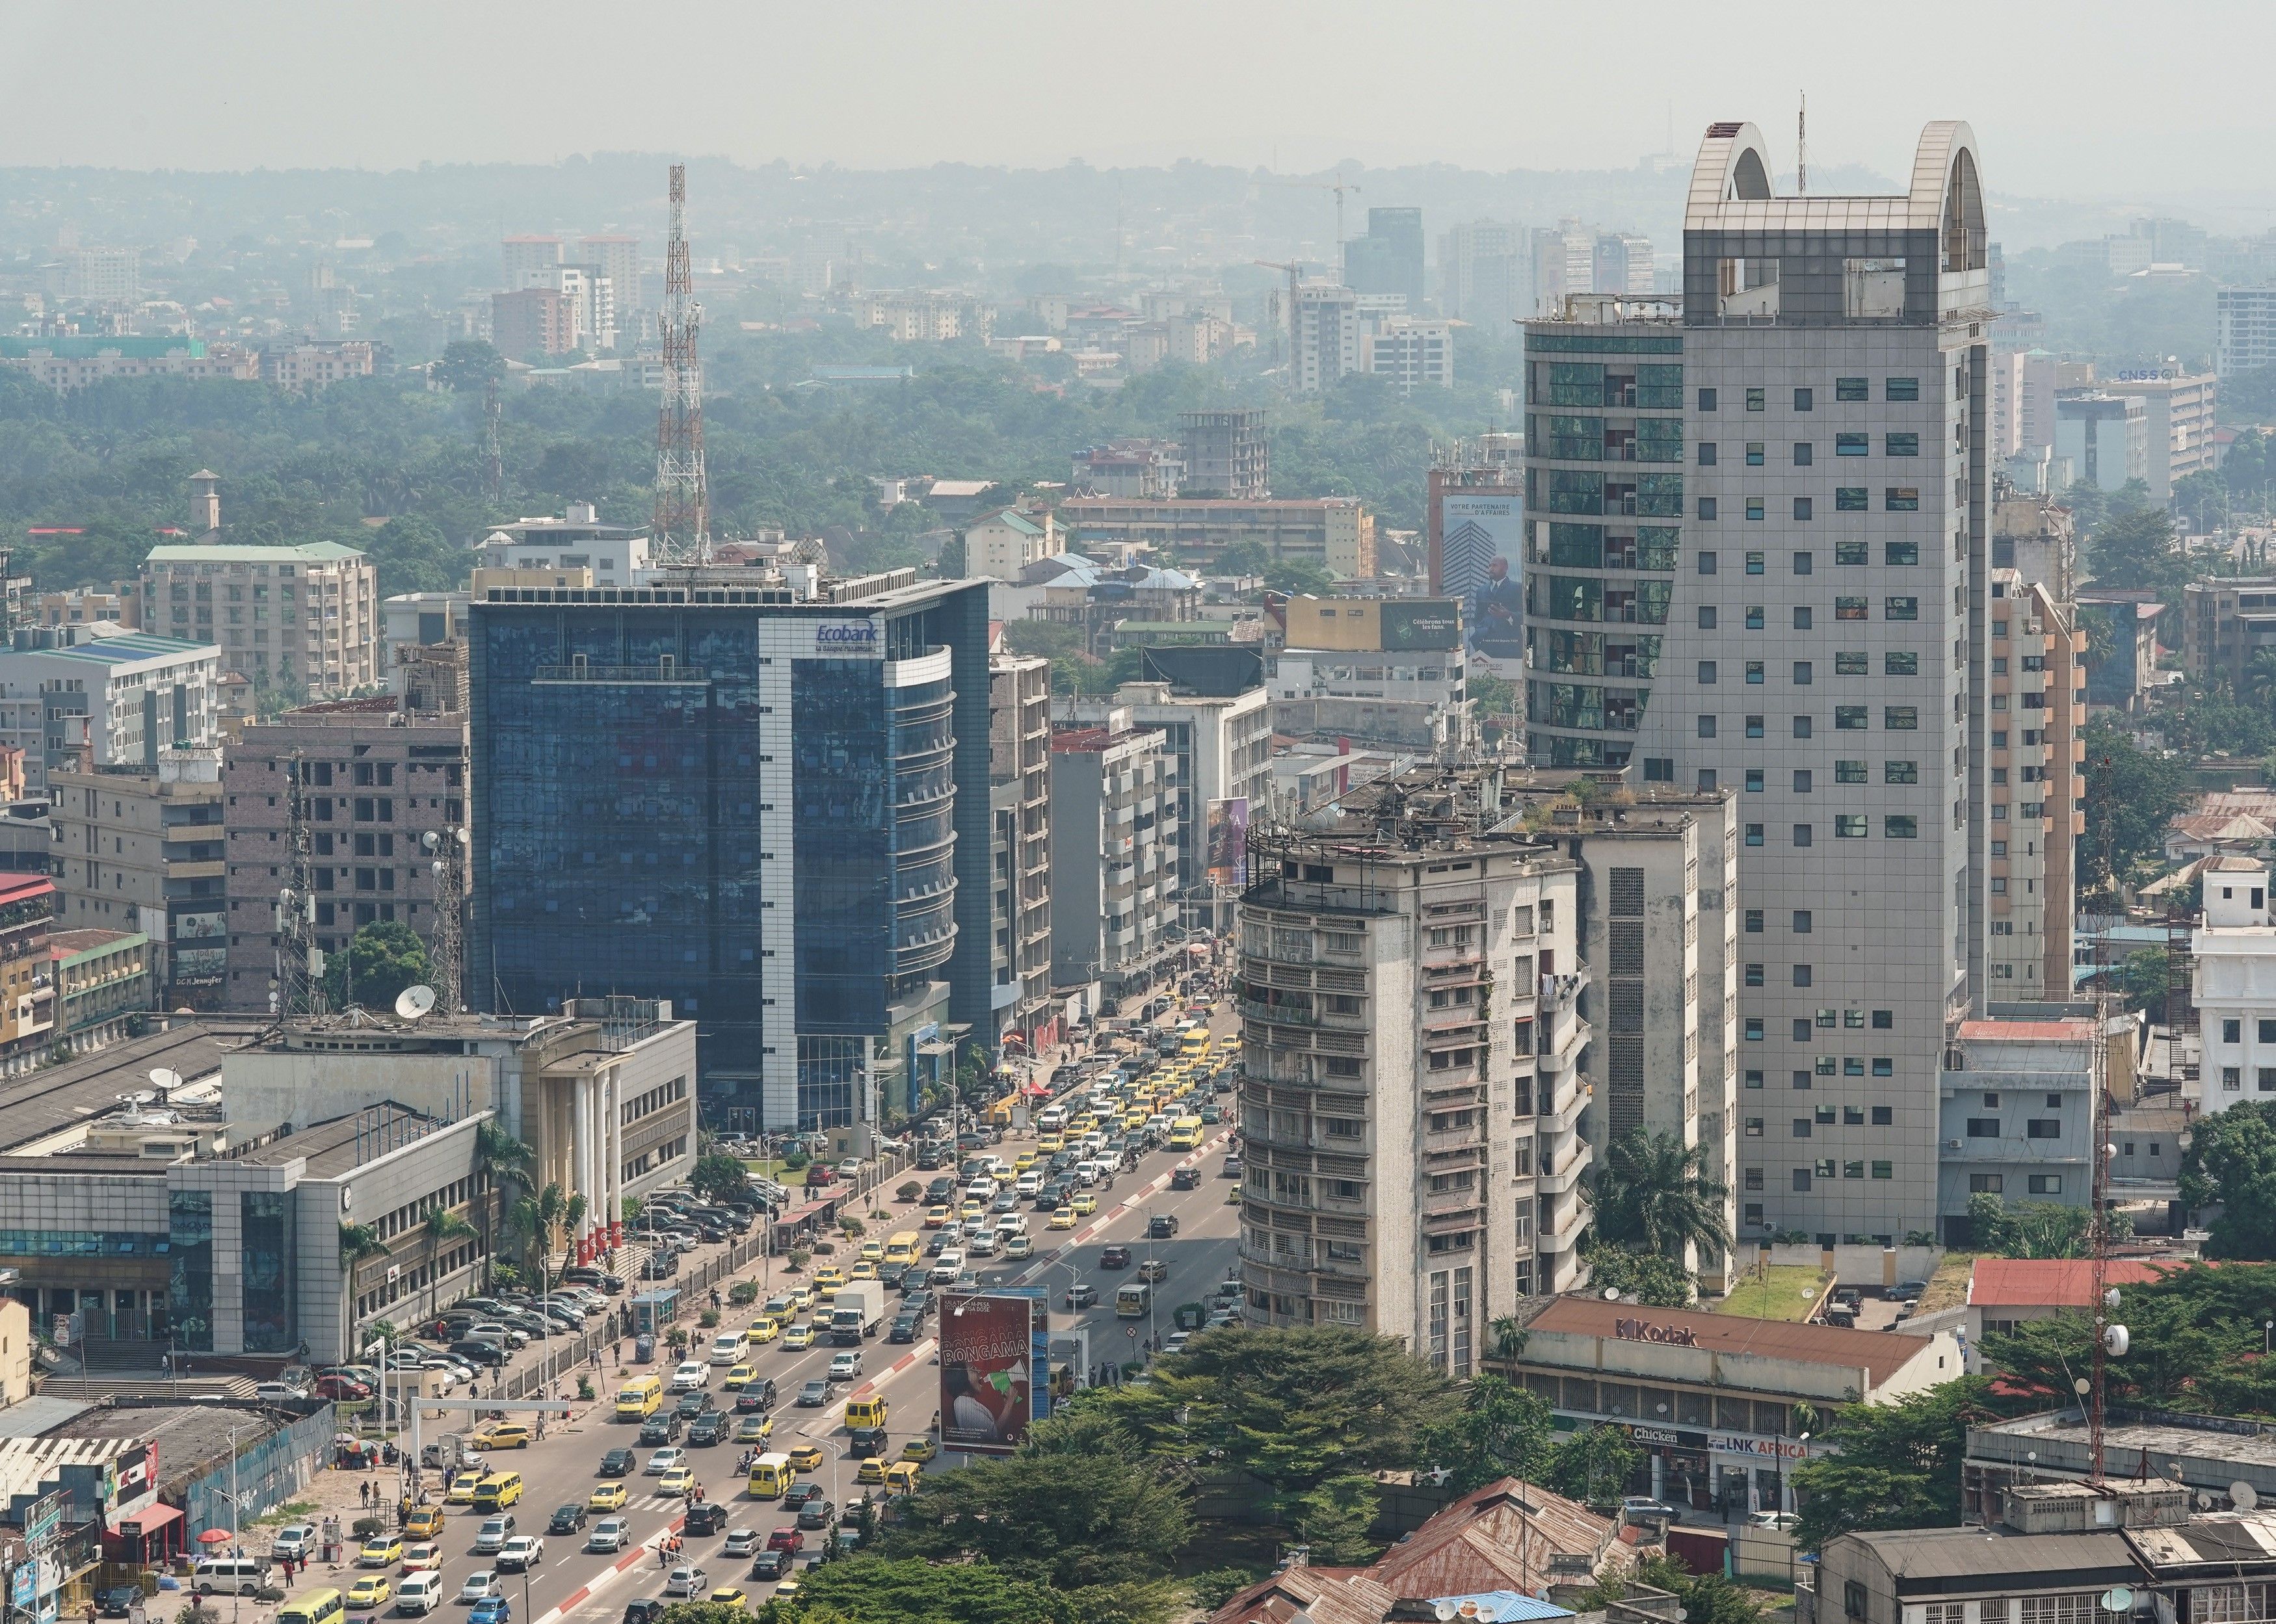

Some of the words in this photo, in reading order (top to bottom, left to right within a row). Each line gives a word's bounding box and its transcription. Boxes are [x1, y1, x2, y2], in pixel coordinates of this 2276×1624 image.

[2119, 370, 2158, 380] CNSS
[817, 620, 878, 642] Ecobank
[192, 976, 223, 986] Jennyfer
[1635, 1320, 1699, 1347] Kodak
[943, 1339, 1029, 1366] BONGAMA
[1634, 1427, 1678, 1443] Chicken
[1727, 1437, 1754, 1453] LNK
[1757, 1441, 1806, 1458] AFRICA
